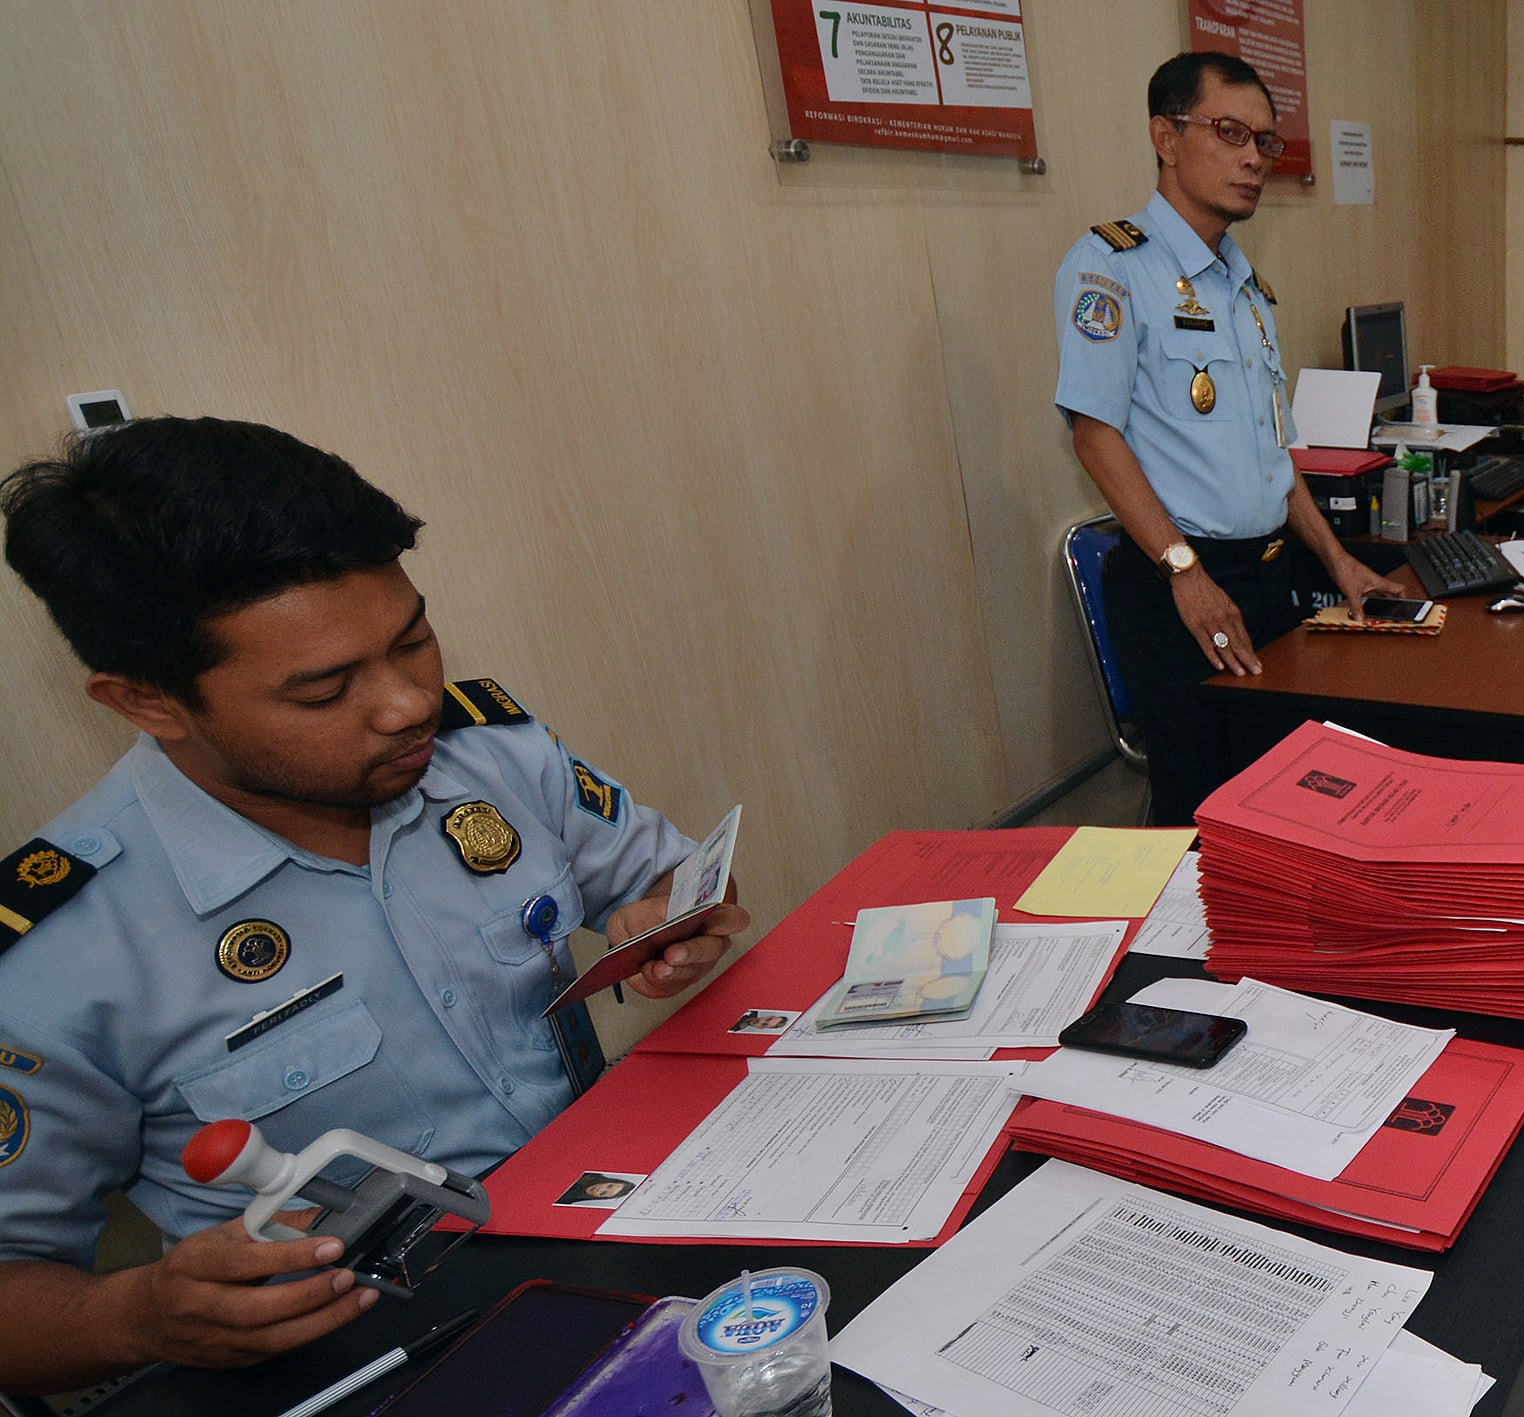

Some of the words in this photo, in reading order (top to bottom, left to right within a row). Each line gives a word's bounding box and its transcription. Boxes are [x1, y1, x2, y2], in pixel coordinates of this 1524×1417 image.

[846, 12, 912, 30] AKUNTABILITAS
[819, 10, 841, 59] 7
[956, 24, 997, 39] PELAYANAN
[997, 29, 1022, 41] PUBLIK
[936, 22, 955, 65] 8
[805, 110, 845, 122] REFORMASI
[847, 115, 882, 126] BIROKRASI
[889, 119, 932, 130] KEMENTERIAN
[479, 679, 522, 716] IMIGRASI
[253, 1013, 282, 1036] FERI
[724, 1318, 785, 1338] AQUA
